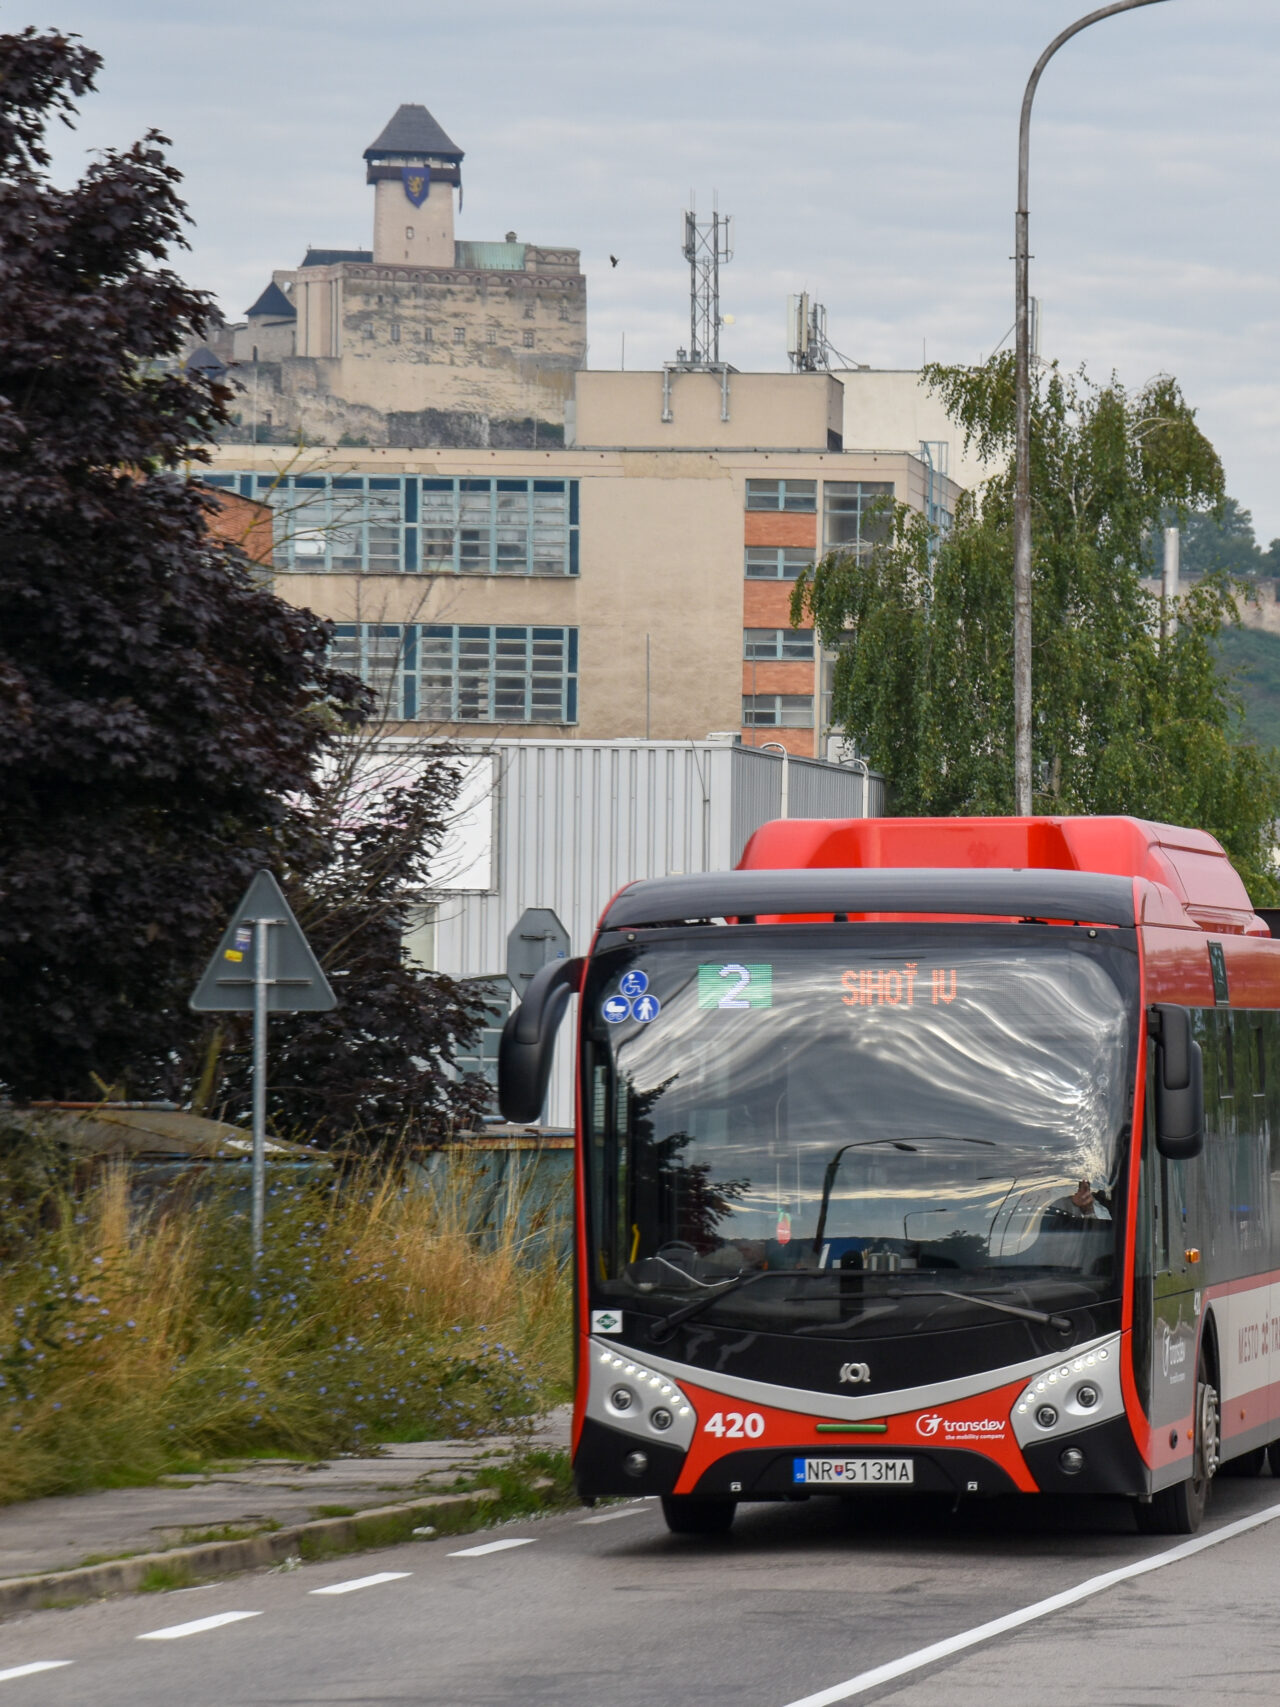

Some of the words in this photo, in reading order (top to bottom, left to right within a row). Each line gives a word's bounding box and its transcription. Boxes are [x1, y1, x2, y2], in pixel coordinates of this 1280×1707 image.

[718, 964, 750, 1009] 2
[842, 963, 918, 1006] SIHOŤ
[932, 969, 957, 1005] IV
[1237, 1322, 1259, 1364] MESTO
[703, 1411, 766, 1439] 420
[943, 1418, 1006, 1432] transdev
[956, 1433, 979, 1441] mobility
[808, 1461, 833, 1480] NR
[844, 1461, 911, 1481] 513MA
